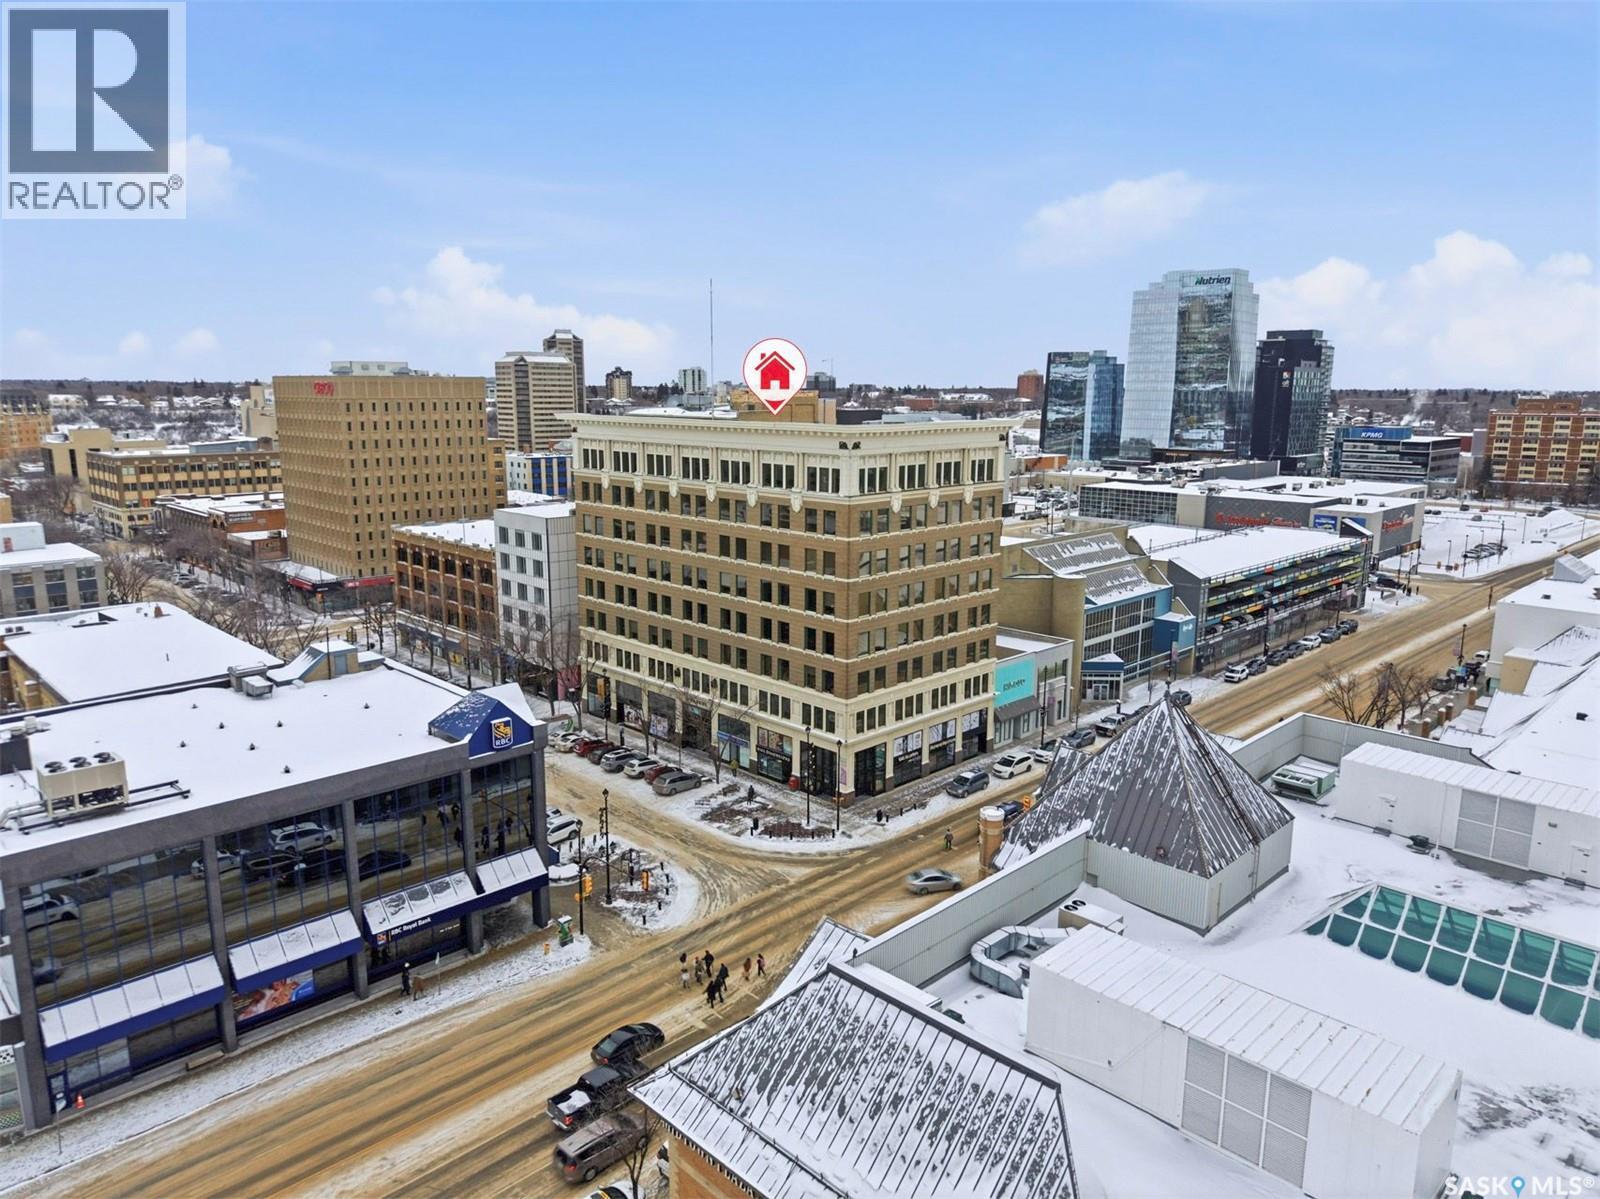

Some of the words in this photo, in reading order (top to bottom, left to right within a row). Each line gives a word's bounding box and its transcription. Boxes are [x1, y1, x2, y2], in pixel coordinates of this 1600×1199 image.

[1195, 274, 1231, 286] Nutrien
[1360, 431, 1384, 439] KPMG
[496, 738, 511, 746] RBC
[418, 917, 431, 926] Bank
